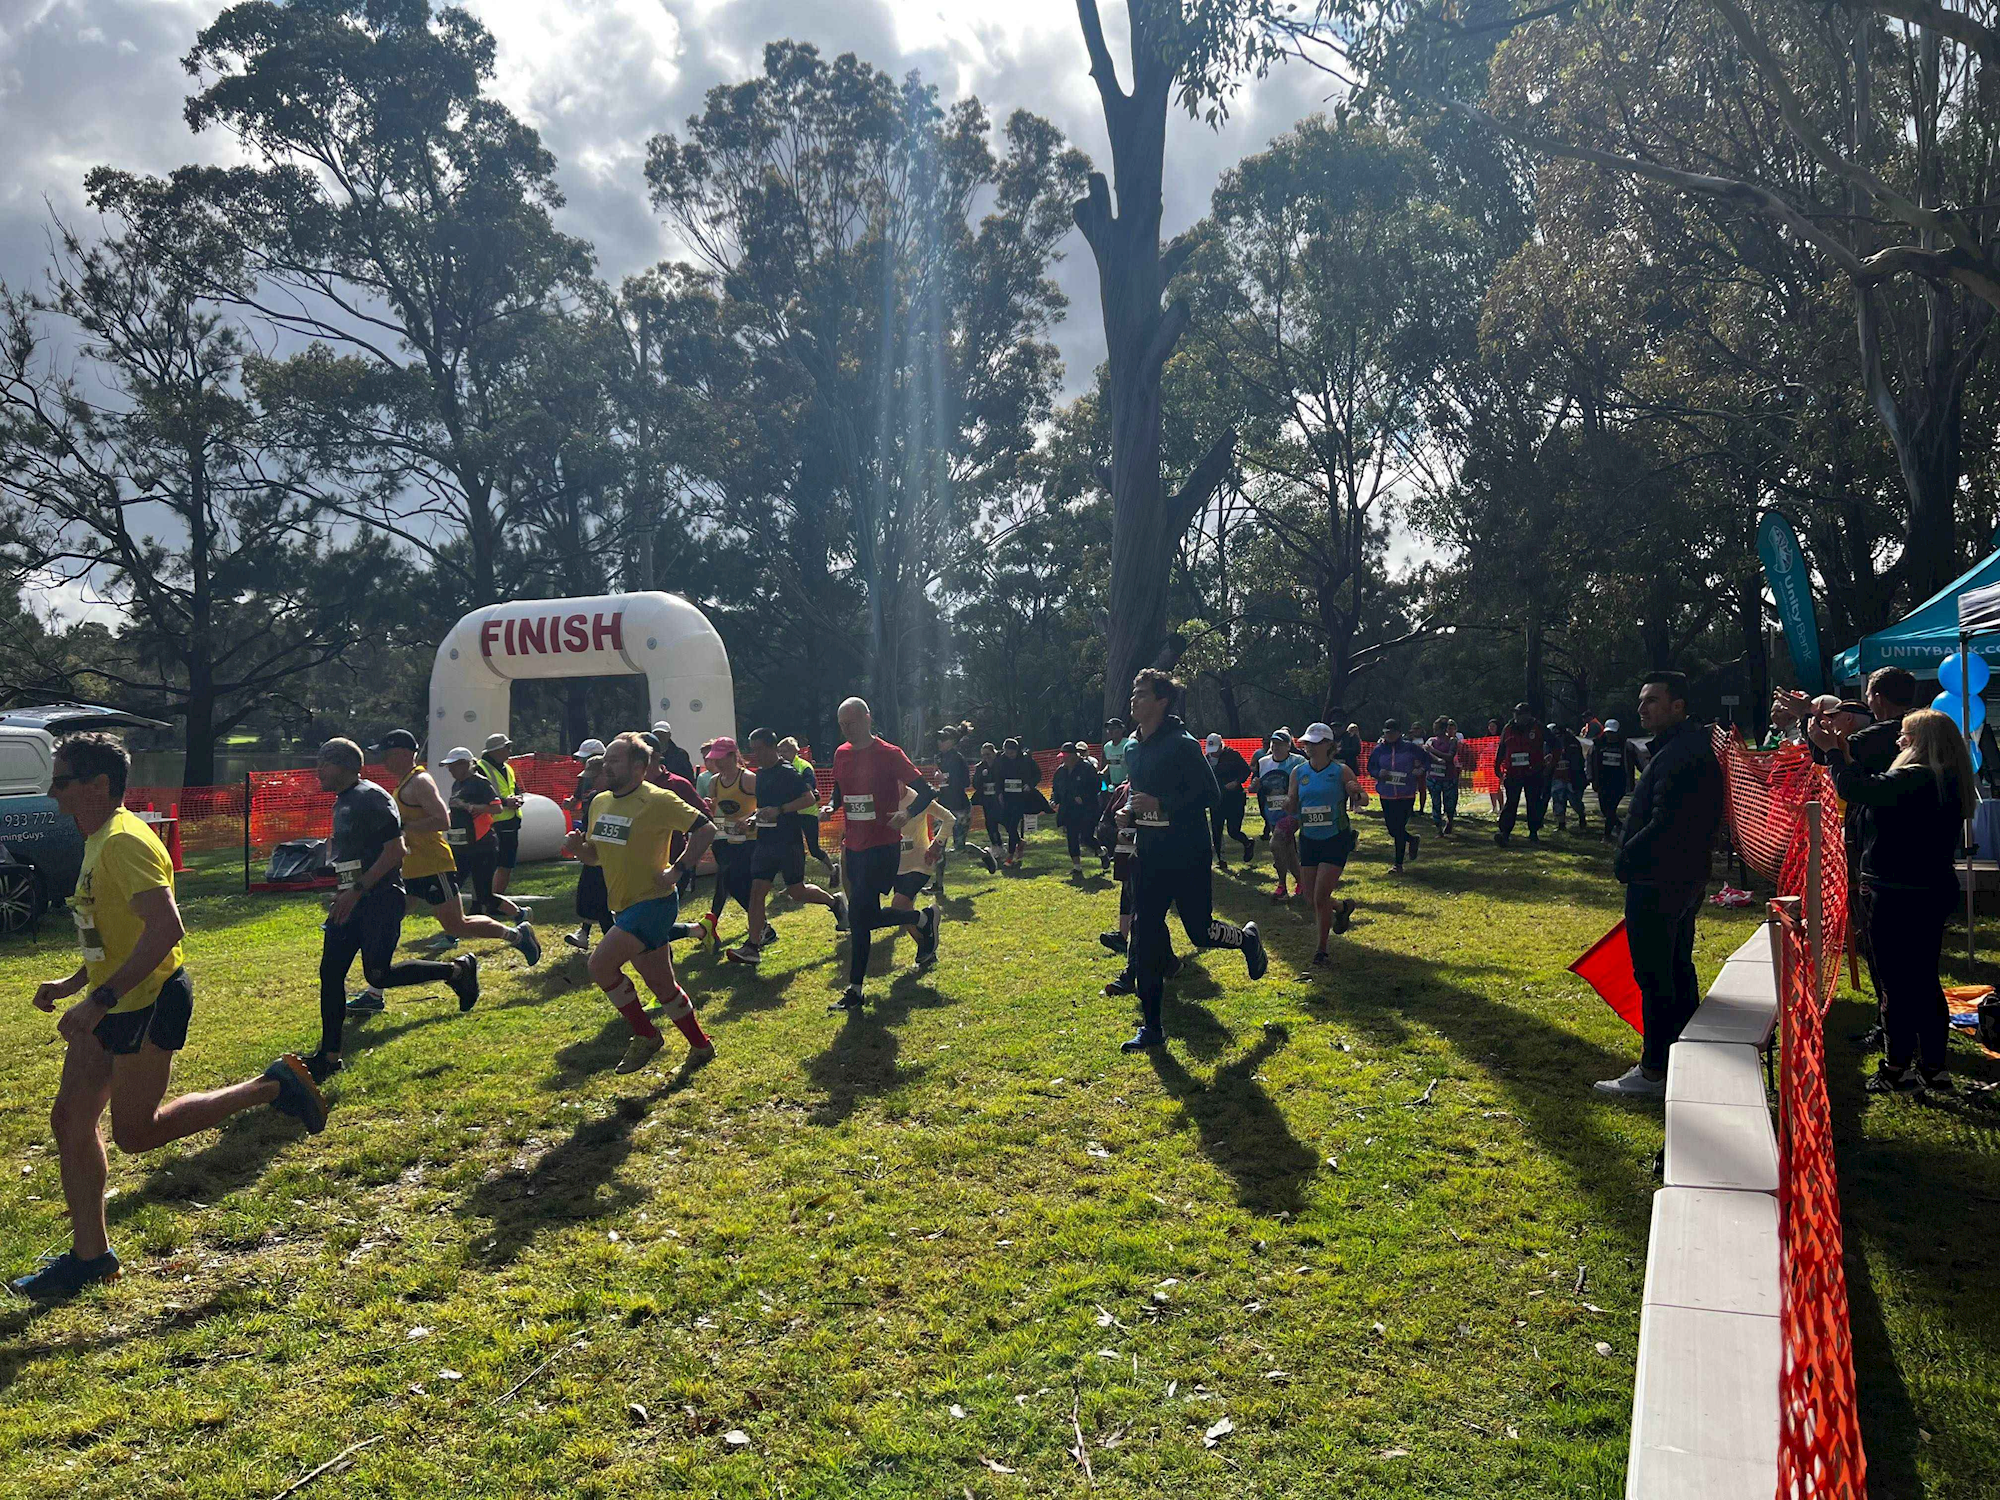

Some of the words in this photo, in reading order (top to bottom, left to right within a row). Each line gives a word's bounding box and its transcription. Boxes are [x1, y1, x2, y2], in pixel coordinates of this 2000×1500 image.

[480, 612, 623, 656] FINISH
[850, 803, 866, 812] 356
[4, 813, 28, 827] 933
[32, 811, 55, 825] 772
[1307, 813, 1324, 823] 380
[600, 824, 620, 838] 335
